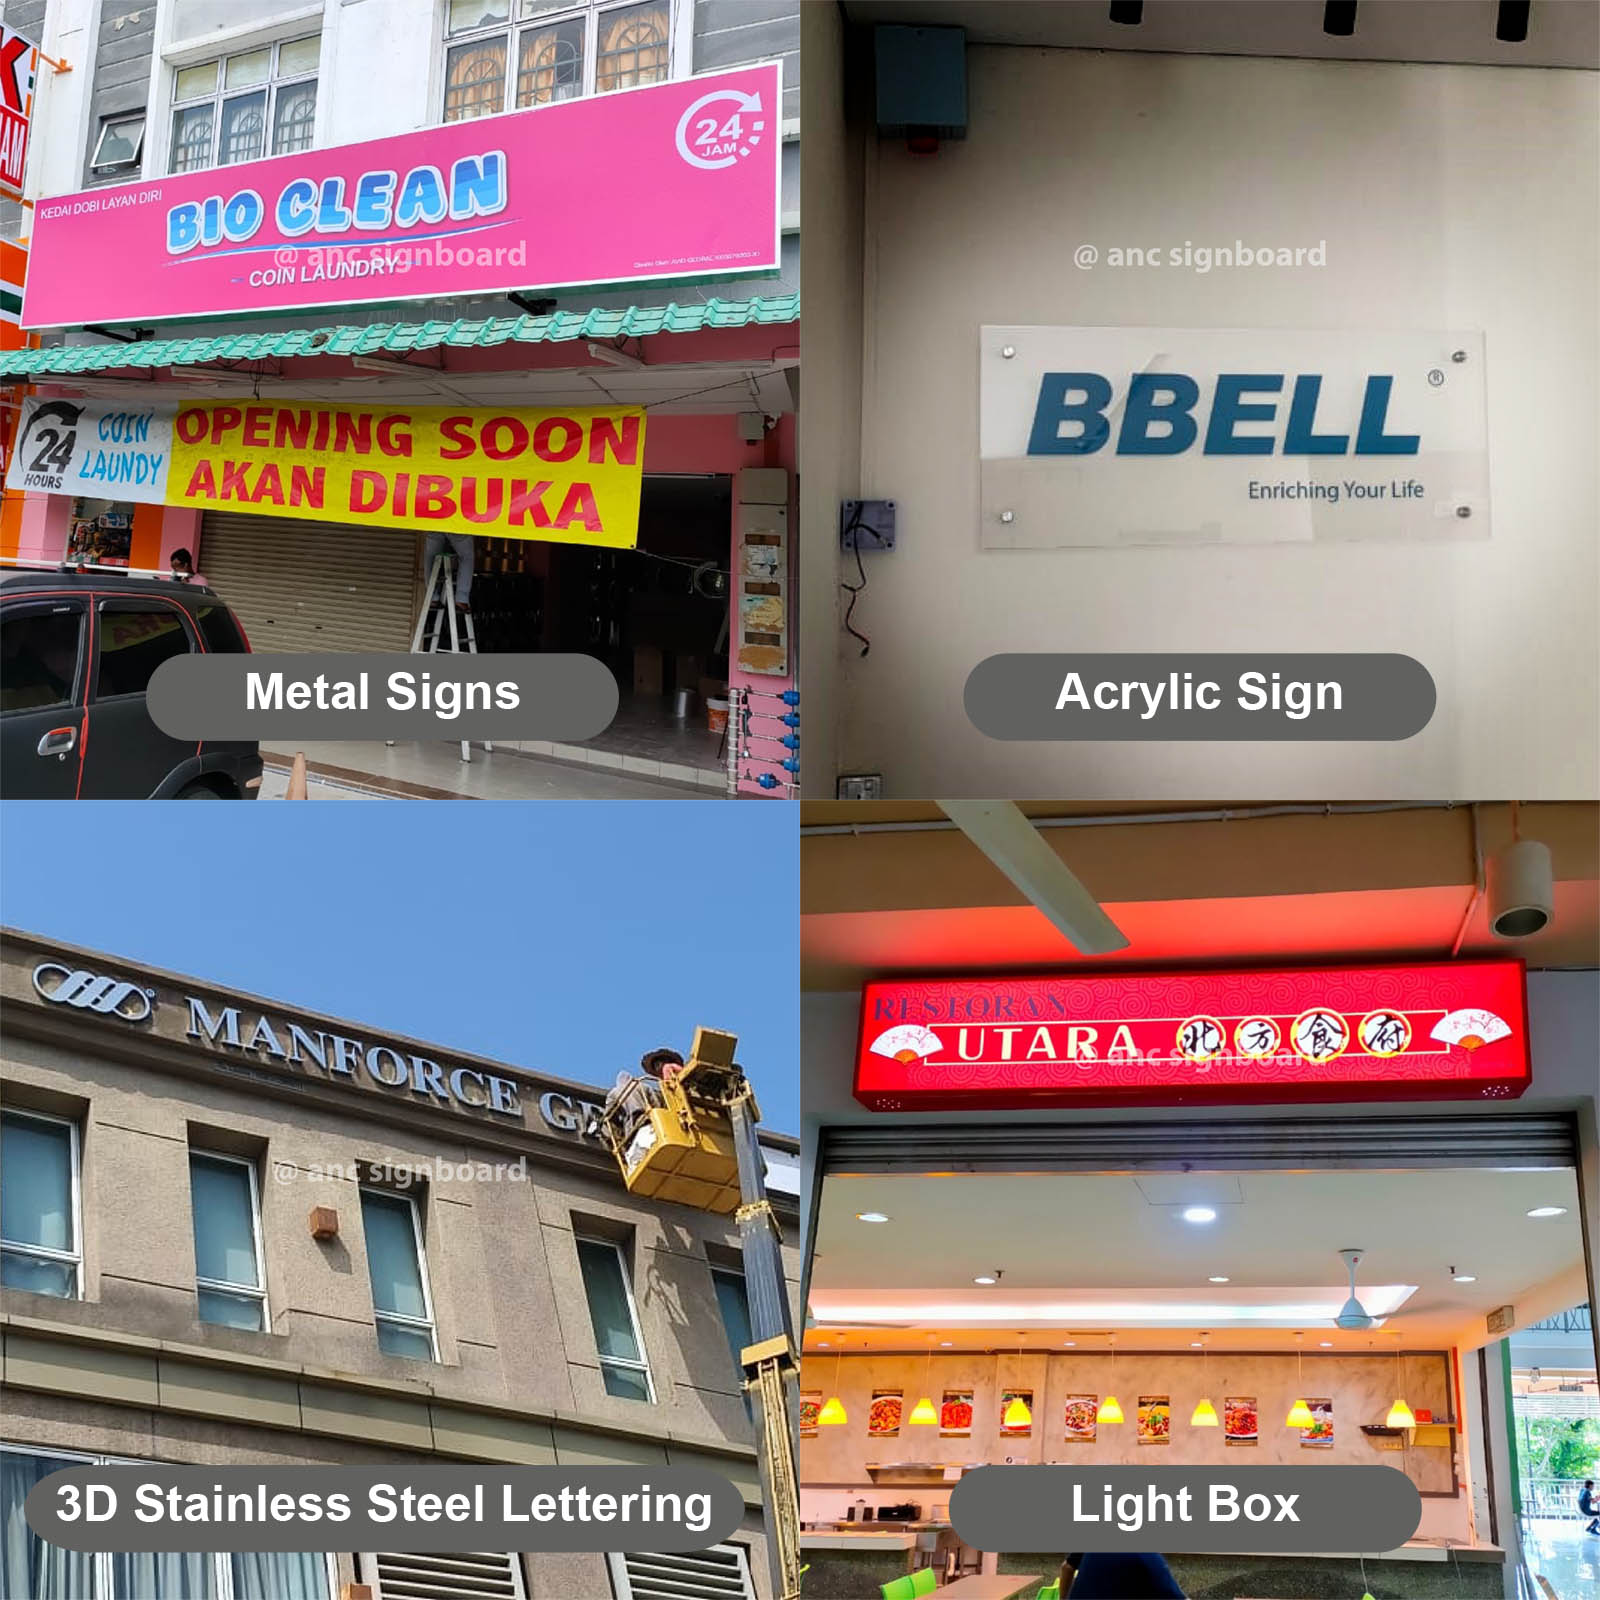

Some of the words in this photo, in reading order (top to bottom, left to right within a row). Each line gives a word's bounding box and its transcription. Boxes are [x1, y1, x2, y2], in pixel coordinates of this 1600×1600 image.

[695, 113, 744, 146] 24
[702, 142, 737, 157] JAM
[40, 206, 72, 220] KEDAI
[74, 200, 100, 215] DOBI
[102, 194, 137, 210] LAYAN
[139, 189, 162, 204] DIRI
[167, 189, 264, 255] BIO
[276, 150, 507, 238] CLEAN
[249, 265, 295, 287] COIN
[302, 255, 400, 283] LAUNDRY
[98, 412, 153, 444] COIN
[1026, 372, 1421, 456] BBELL
[29, 428, 77, 474] 24
[175, 407, 412, 458] OPENING
[439, 416, 641, 466] SOON
[24, 474, 64, 489] HOURS
[79, 450, 163, 485] LAUNDY
[185, 459, 325, 509] AKAN
[349, 469, 604, 533] DIBUKA
[1248, 481, 1340, 503] Enriching
[1344, 481, 1387, 499] Your
[1391, 480, 1425, 499] Life
[873, 994, 1065, 1021] RESTORAN
[957, 1025, 1138, 1060] UTARA
[1182, 1012, 1405, 1058] 北方食府
[184, 995, 523, 1118] MANFORCE
